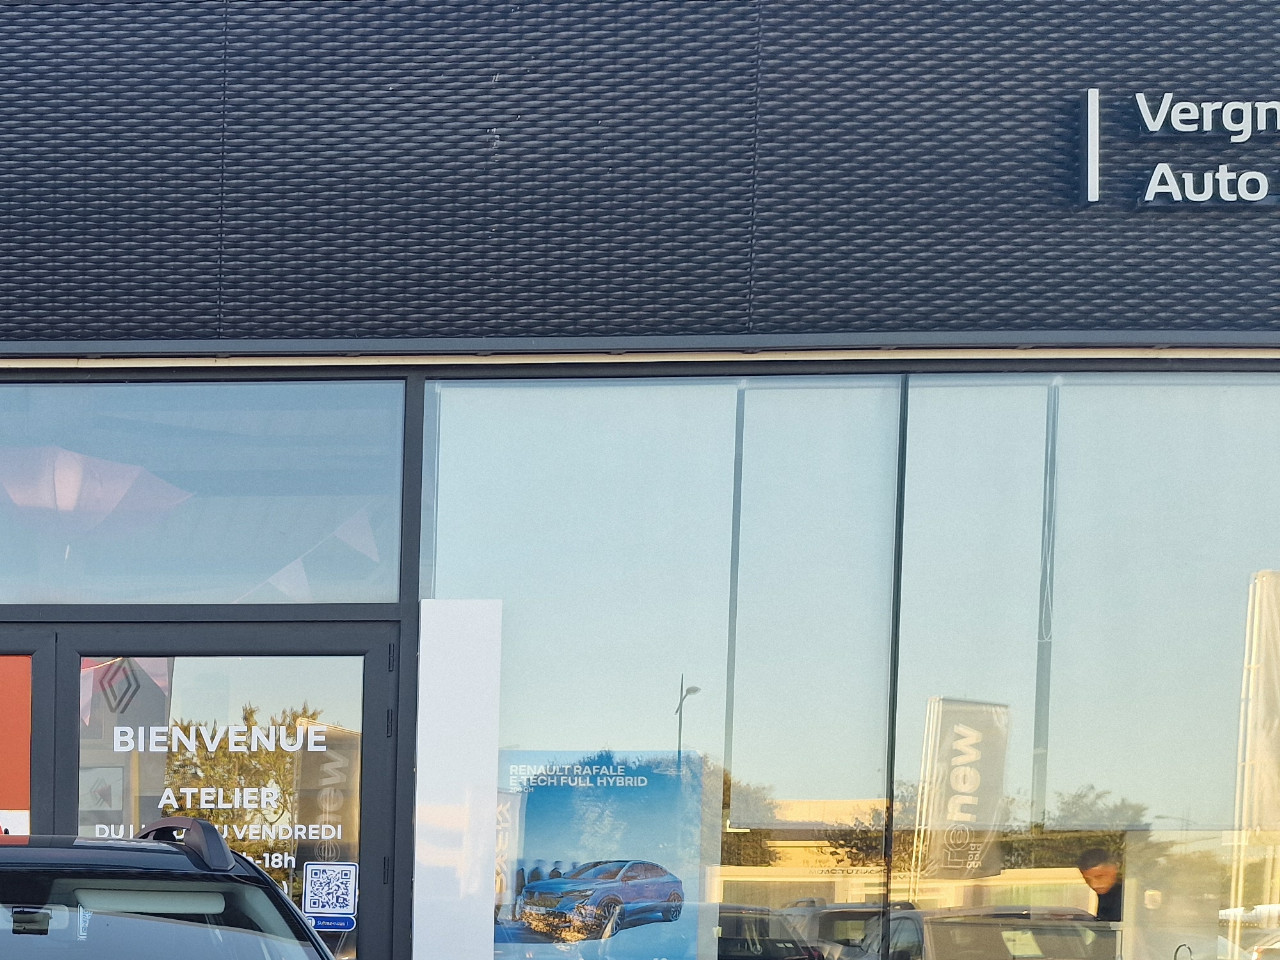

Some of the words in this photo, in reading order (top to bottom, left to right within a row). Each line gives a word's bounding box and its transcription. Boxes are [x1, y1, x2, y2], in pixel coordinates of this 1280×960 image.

[1144, 162, 1269, 202] Auto
[113, 725, 327, 752] BIENVENUE
[509, 764, 570, 776] RENAULT
[573, 765, 626, 776] RAFALE
[509, 775, 557, 787] E-TECH
[560, 776, 594, 787] FULL
[597, 776, 648, 788] HYBRID
[157, 787, 279, 809] ATELIER
[95, 824, 125, 839] DU
[234, 824, 342, 840] VENDREDI
